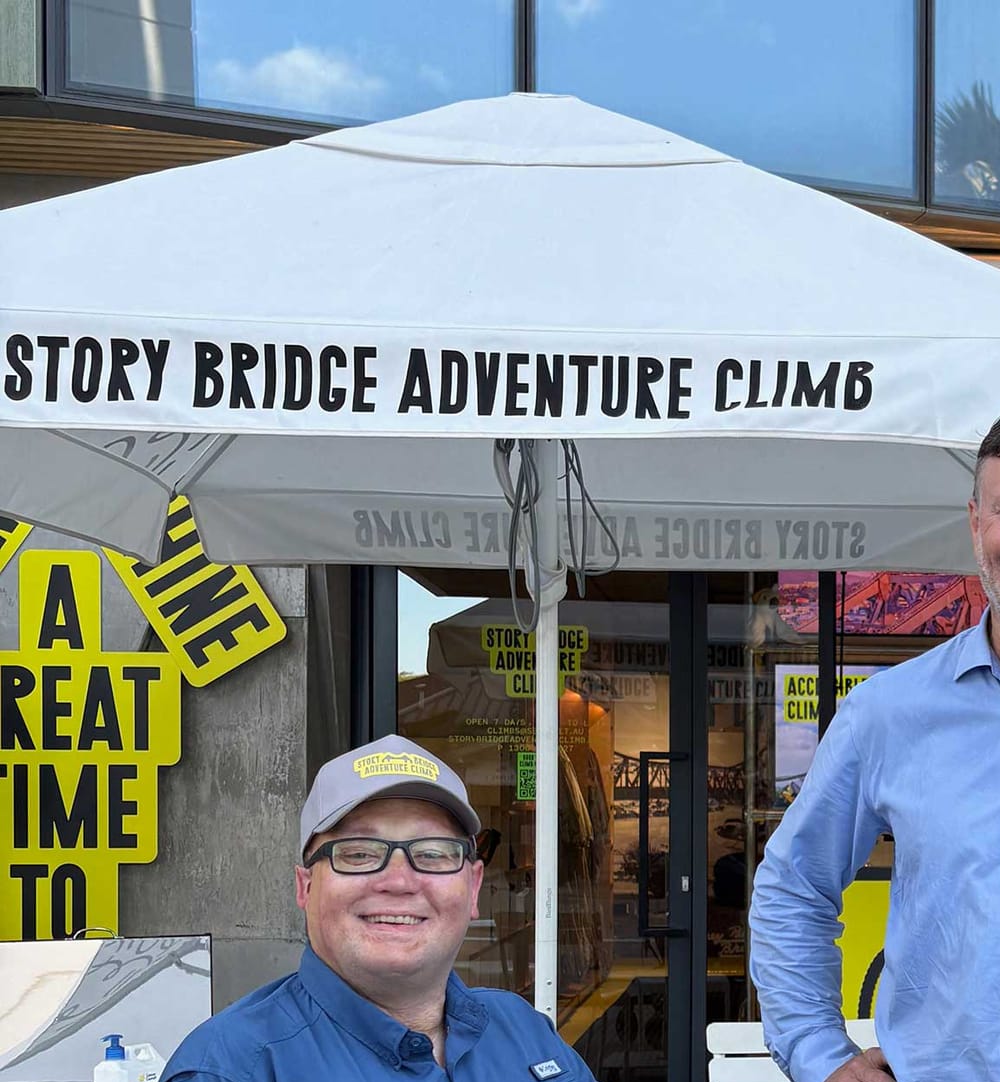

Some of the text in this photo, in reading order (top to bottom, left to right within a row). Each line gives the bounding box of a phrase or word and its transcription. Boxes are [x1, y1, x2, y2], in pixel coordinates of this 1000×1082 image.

[4, 333, 875, 420] STORY BRIDGE ADVENTURE CLIMB
[38, 564, 84, 650] A
[487, 628, 584, 649] STORY DGE
[496, 651, 576, 671] ADVERE
[513, 673, 537, 693] CLI
[0, 665, 161, 751] REAT
[788, 701, 820, 719] CLIM
[465, 718, 489, 726] OPEN
[364, 764, 433, 777] ADVENTURE CLIMB
[0, 764, 138, 849] IME
[10, 864, 87, 940] TO
